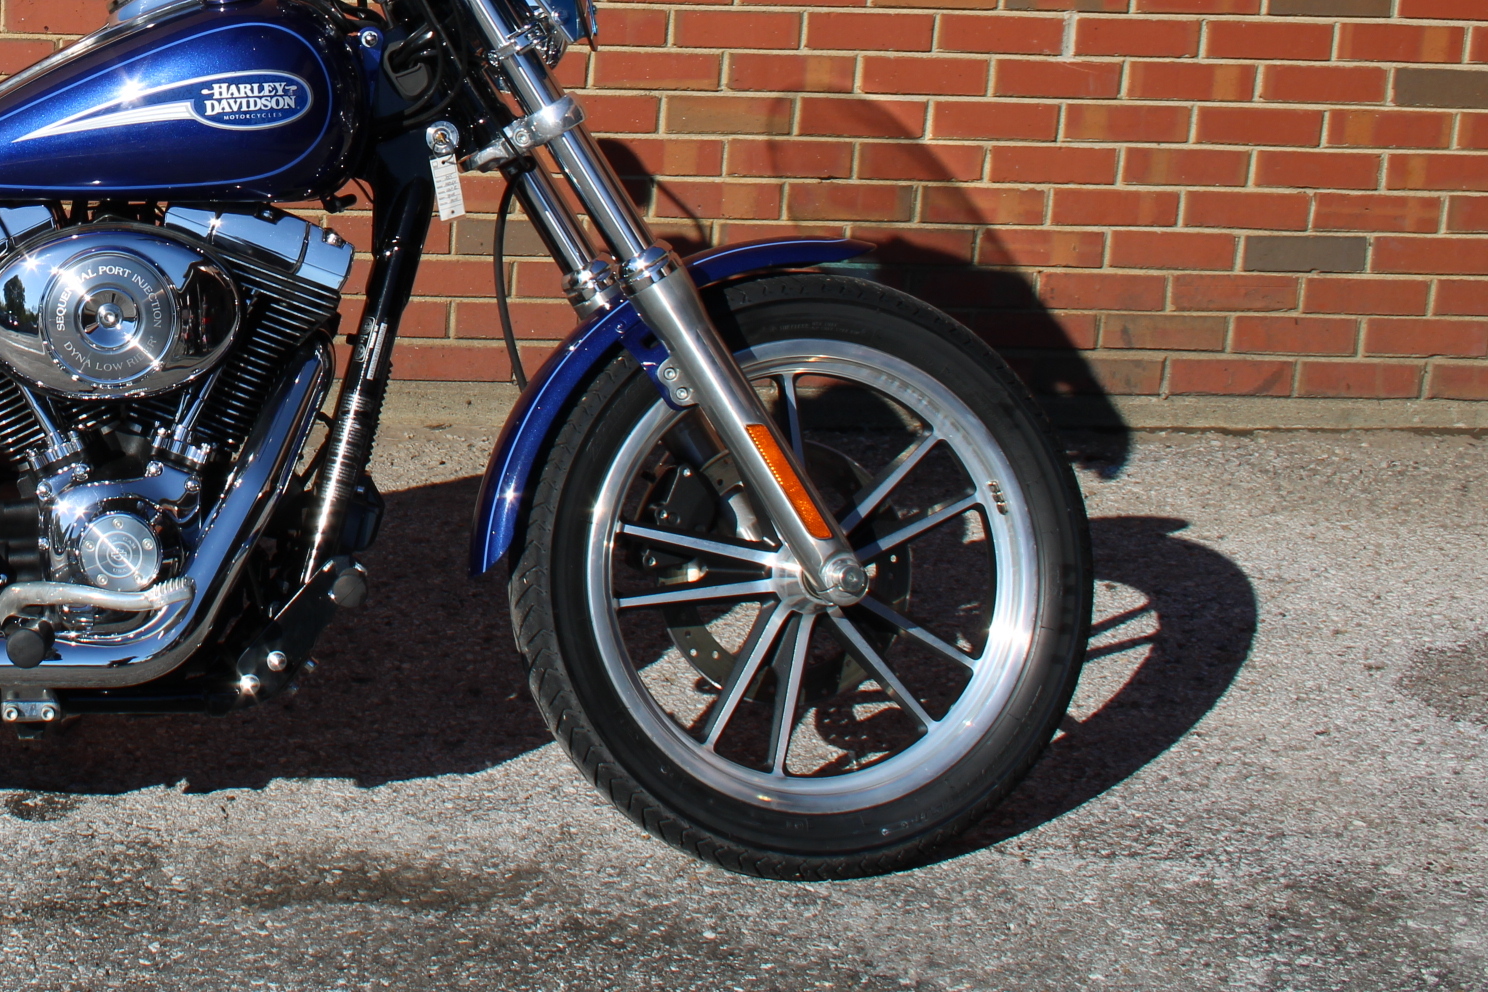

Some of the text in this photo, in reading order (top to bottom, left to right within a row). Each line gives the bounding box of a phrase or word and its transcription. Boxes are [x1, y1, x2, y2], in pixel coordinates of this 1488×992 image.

[212, 82, 288, 99] HARLEY
[204, 96, 296, 116] DAVIDSON
[223, 112, 283, 121] MOTORCYCLES
[98, 265, 132, 278] PORT
[131, 273, 162, 328] INJECTION
[63, 341, 91, 368] DYNA
[95, 362, 124, 372] LOW
